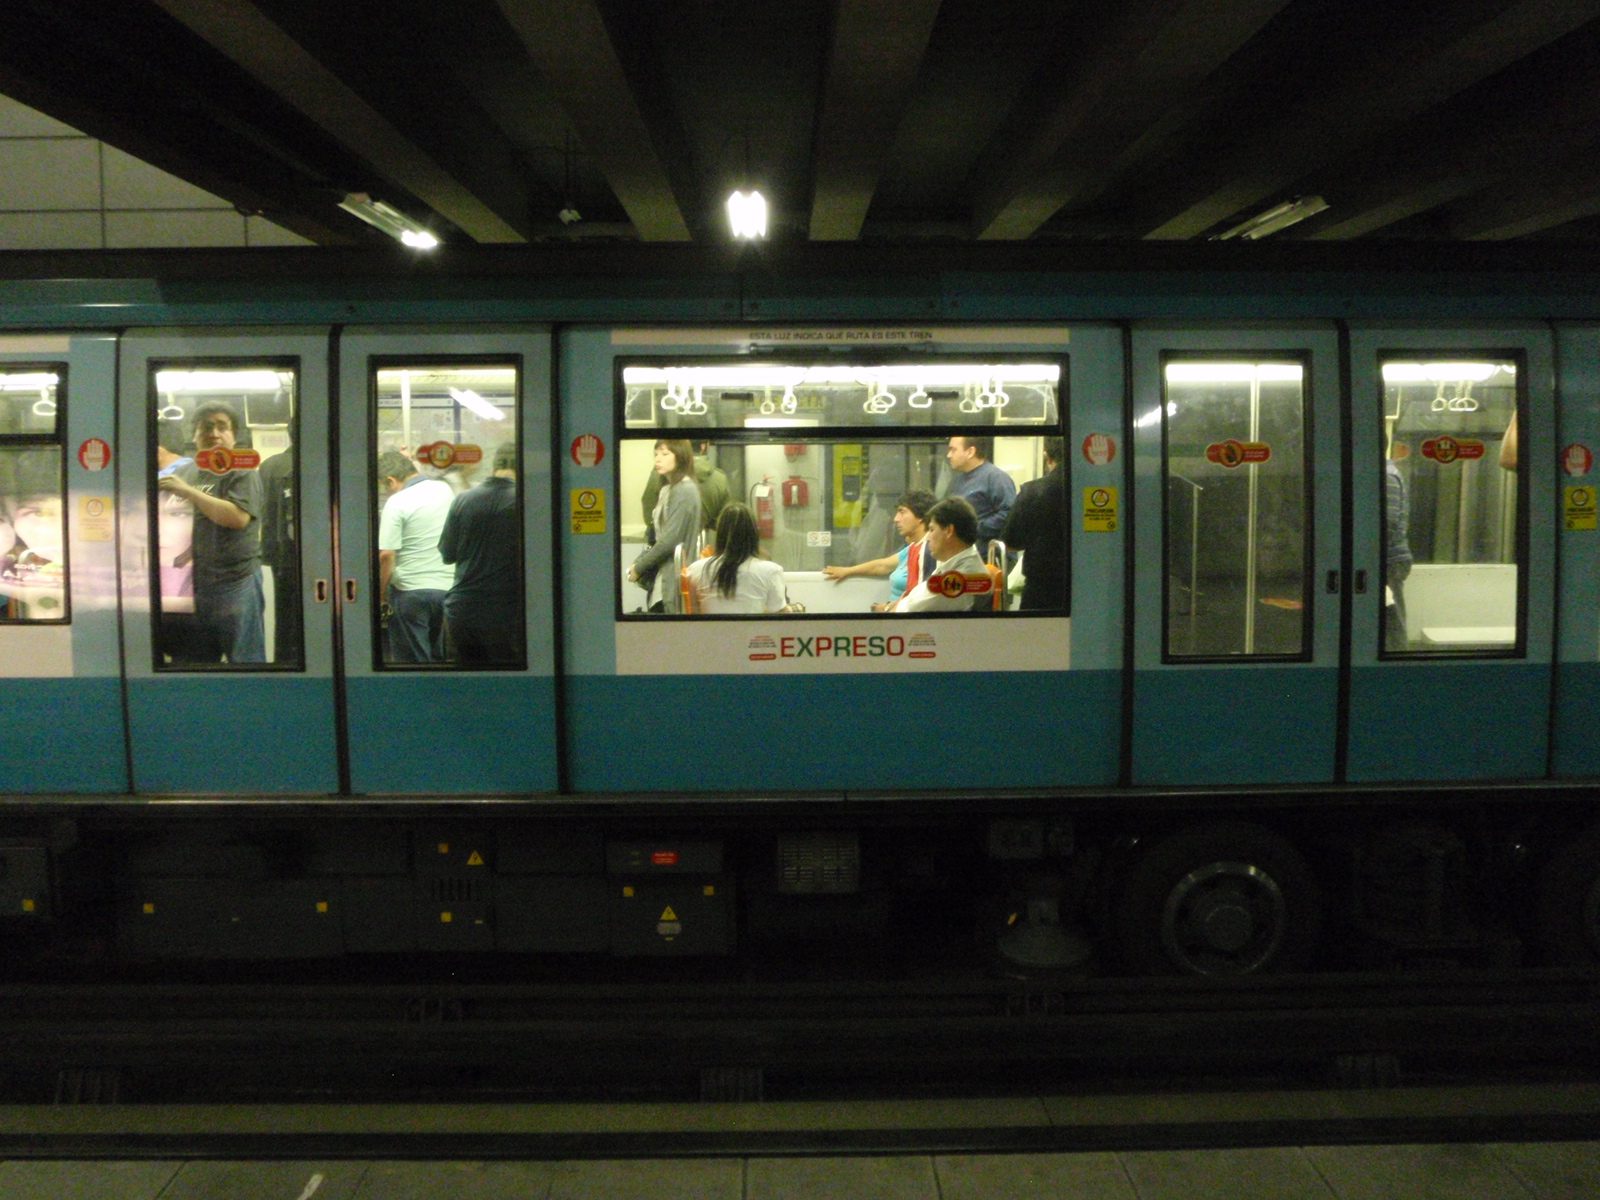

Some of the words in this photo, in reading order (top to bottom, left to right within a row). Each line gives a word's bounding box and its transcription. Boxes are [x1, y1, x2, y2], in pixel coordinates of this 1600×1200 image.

[749, 331, 772, 340] ESTA
[774, 331, 790, 340] LUZ
[793, 331, 824, 340] INDICA
[826, 331, 844, 340] QUE
[846, 331, 870, 340] RUTA
[872, 331, 884, 340] ES
[885, 331, 906, 340] ESTE
[909, 331, 932, 340] TREN
[780, 635, 905, 658] EXPRESO
